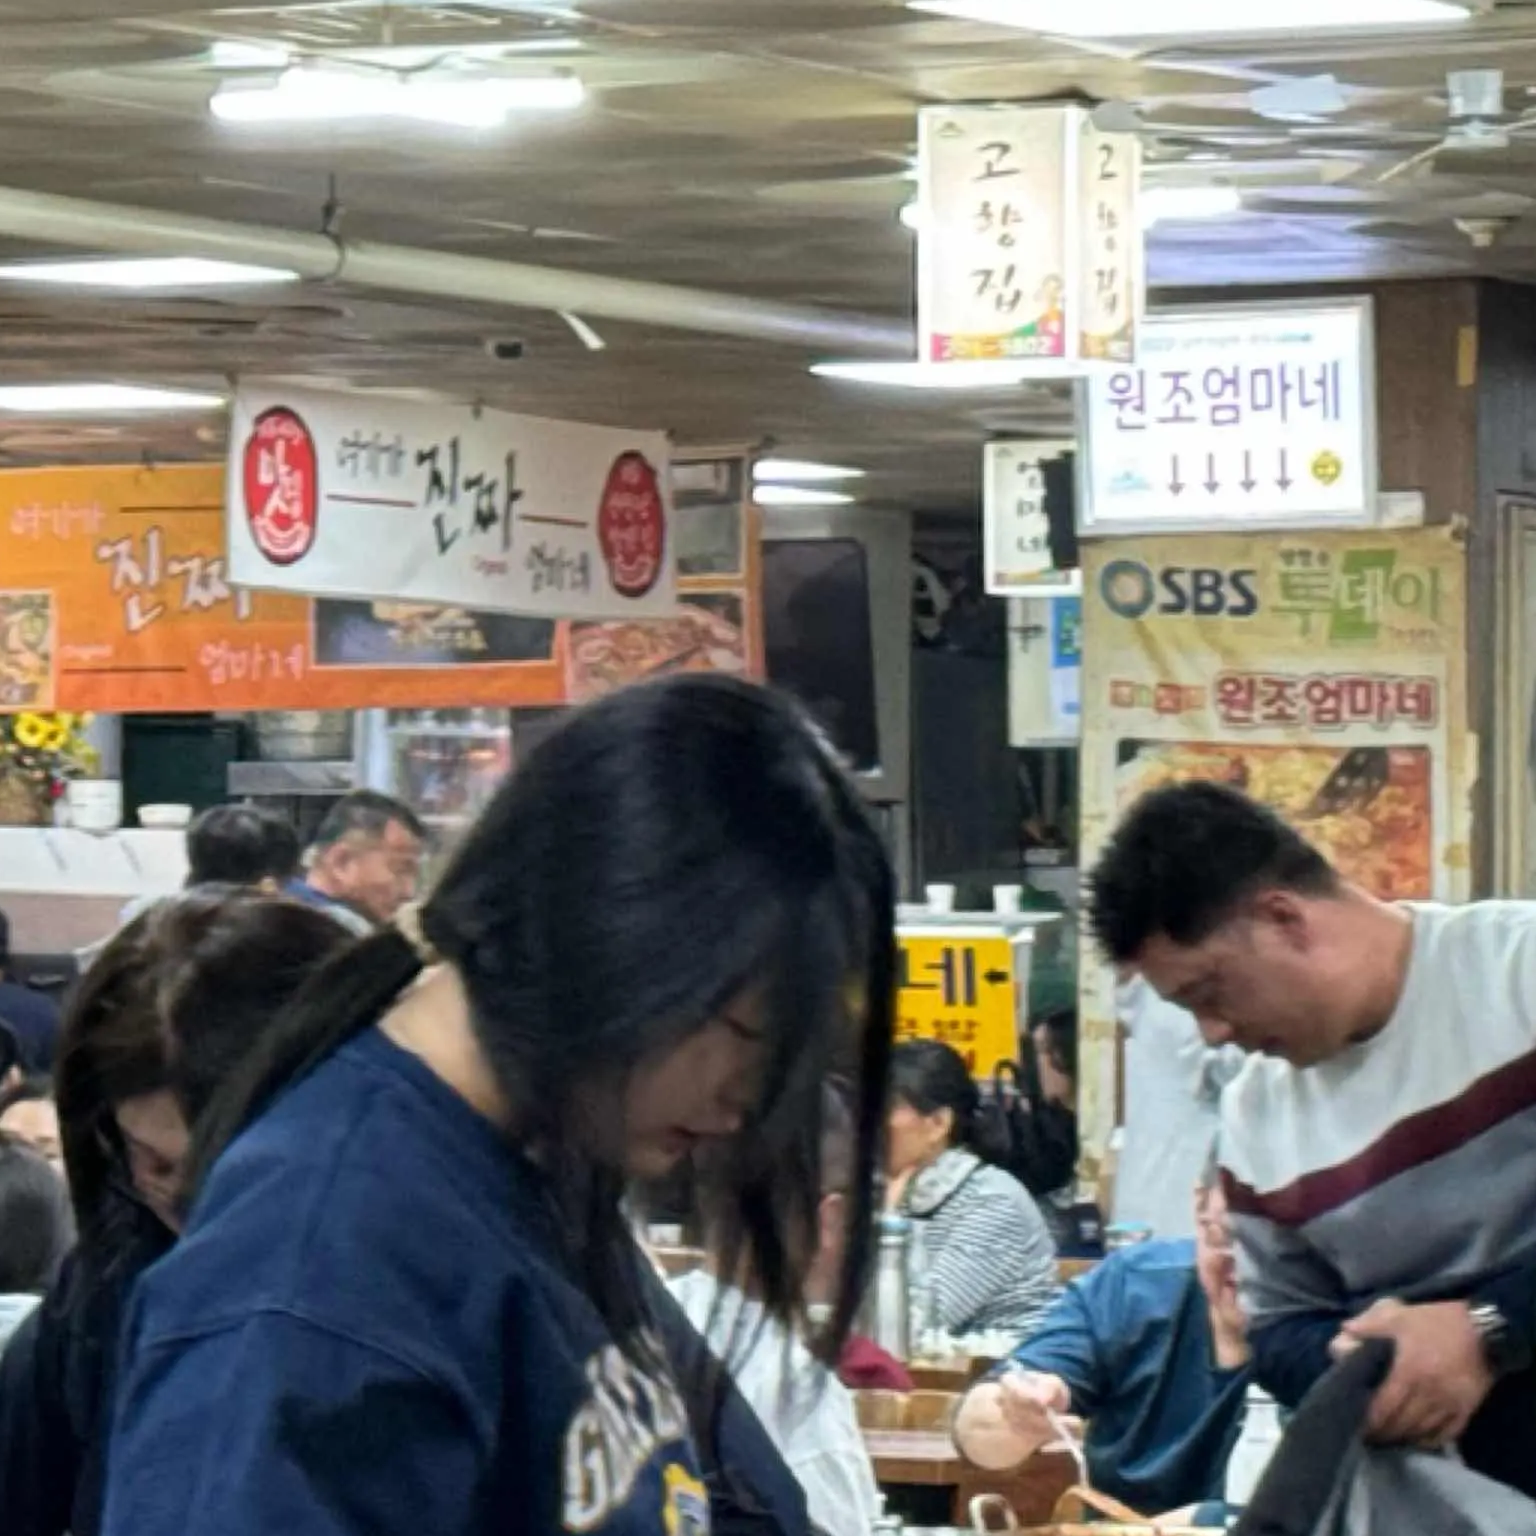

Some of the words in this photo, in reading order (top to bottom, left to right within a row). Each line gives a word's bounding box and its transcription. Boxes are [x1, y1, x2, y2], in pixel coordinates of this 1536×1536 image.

[970, 141, 1024, 313] 고향집
[1106, 360, 1341, 431] 원조엄마네
[417, 436, 522, 554] 진짜
[1157, 567, 1259, 616] SBS
[1271, 566, 1441, 636] 투데이
[1217, 676, 1436, 725] 원조엄마네
